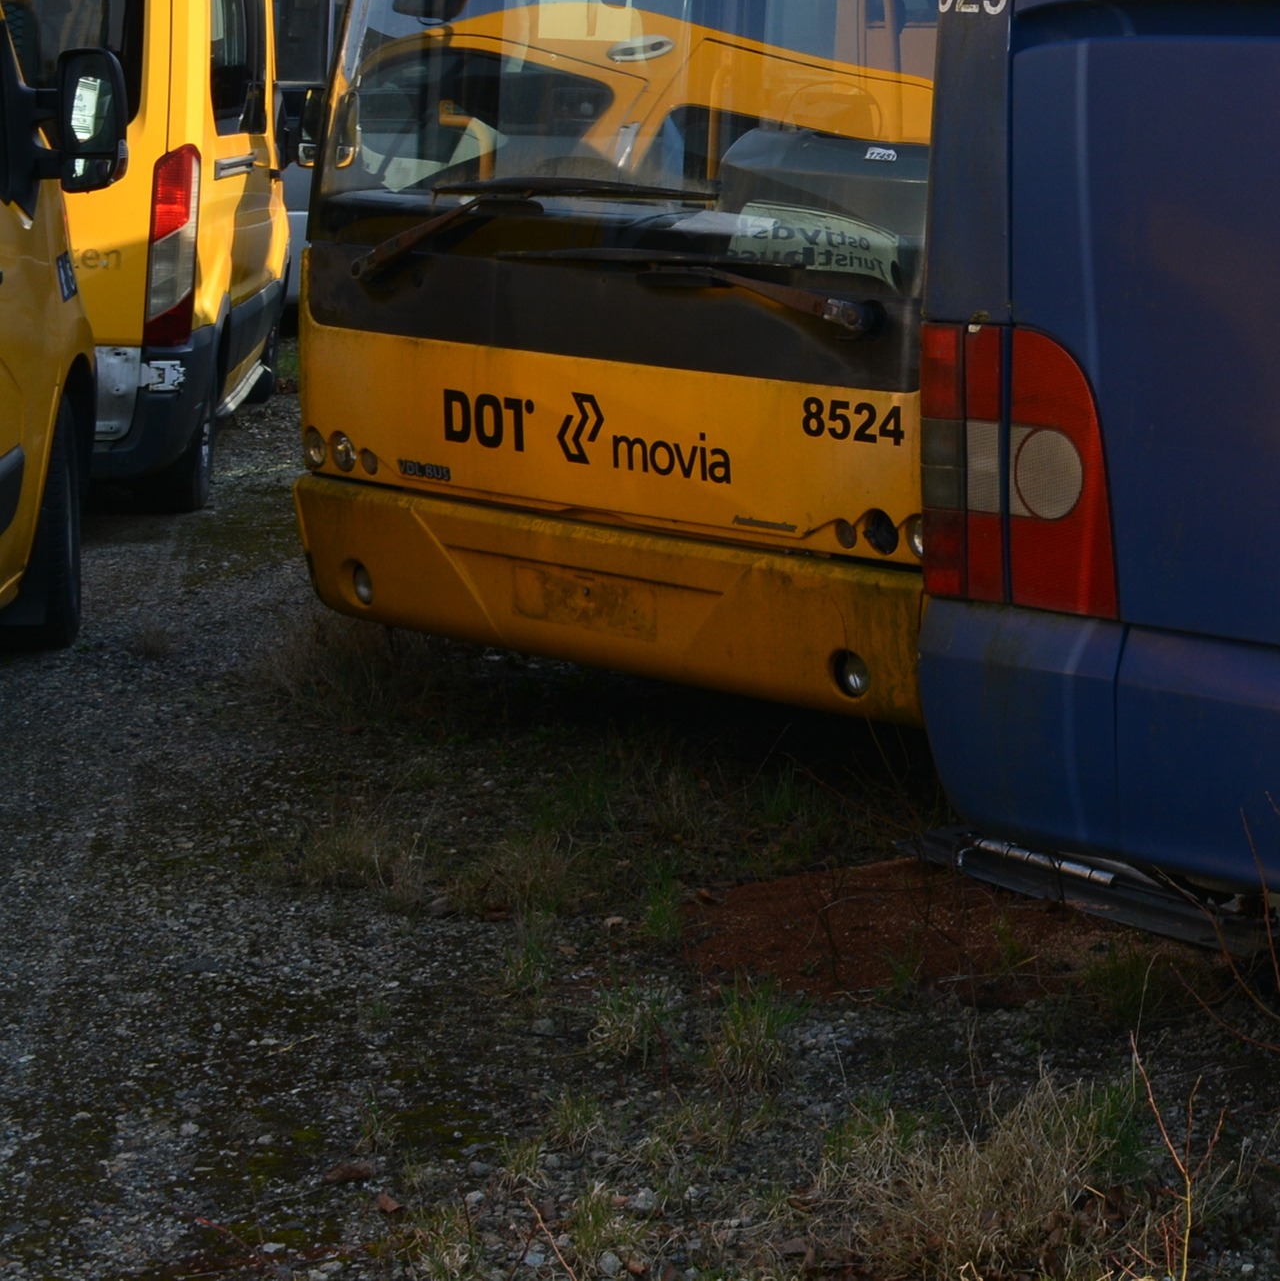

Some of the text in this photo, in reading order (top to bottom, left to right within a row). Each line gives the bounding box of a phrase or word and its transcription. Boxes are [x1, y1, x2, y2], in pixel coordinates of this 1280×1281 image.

[802, 396, 905, 447] 8524
[424, 463, 452, 482] BUS
[612, 432, 732, 484] movia
